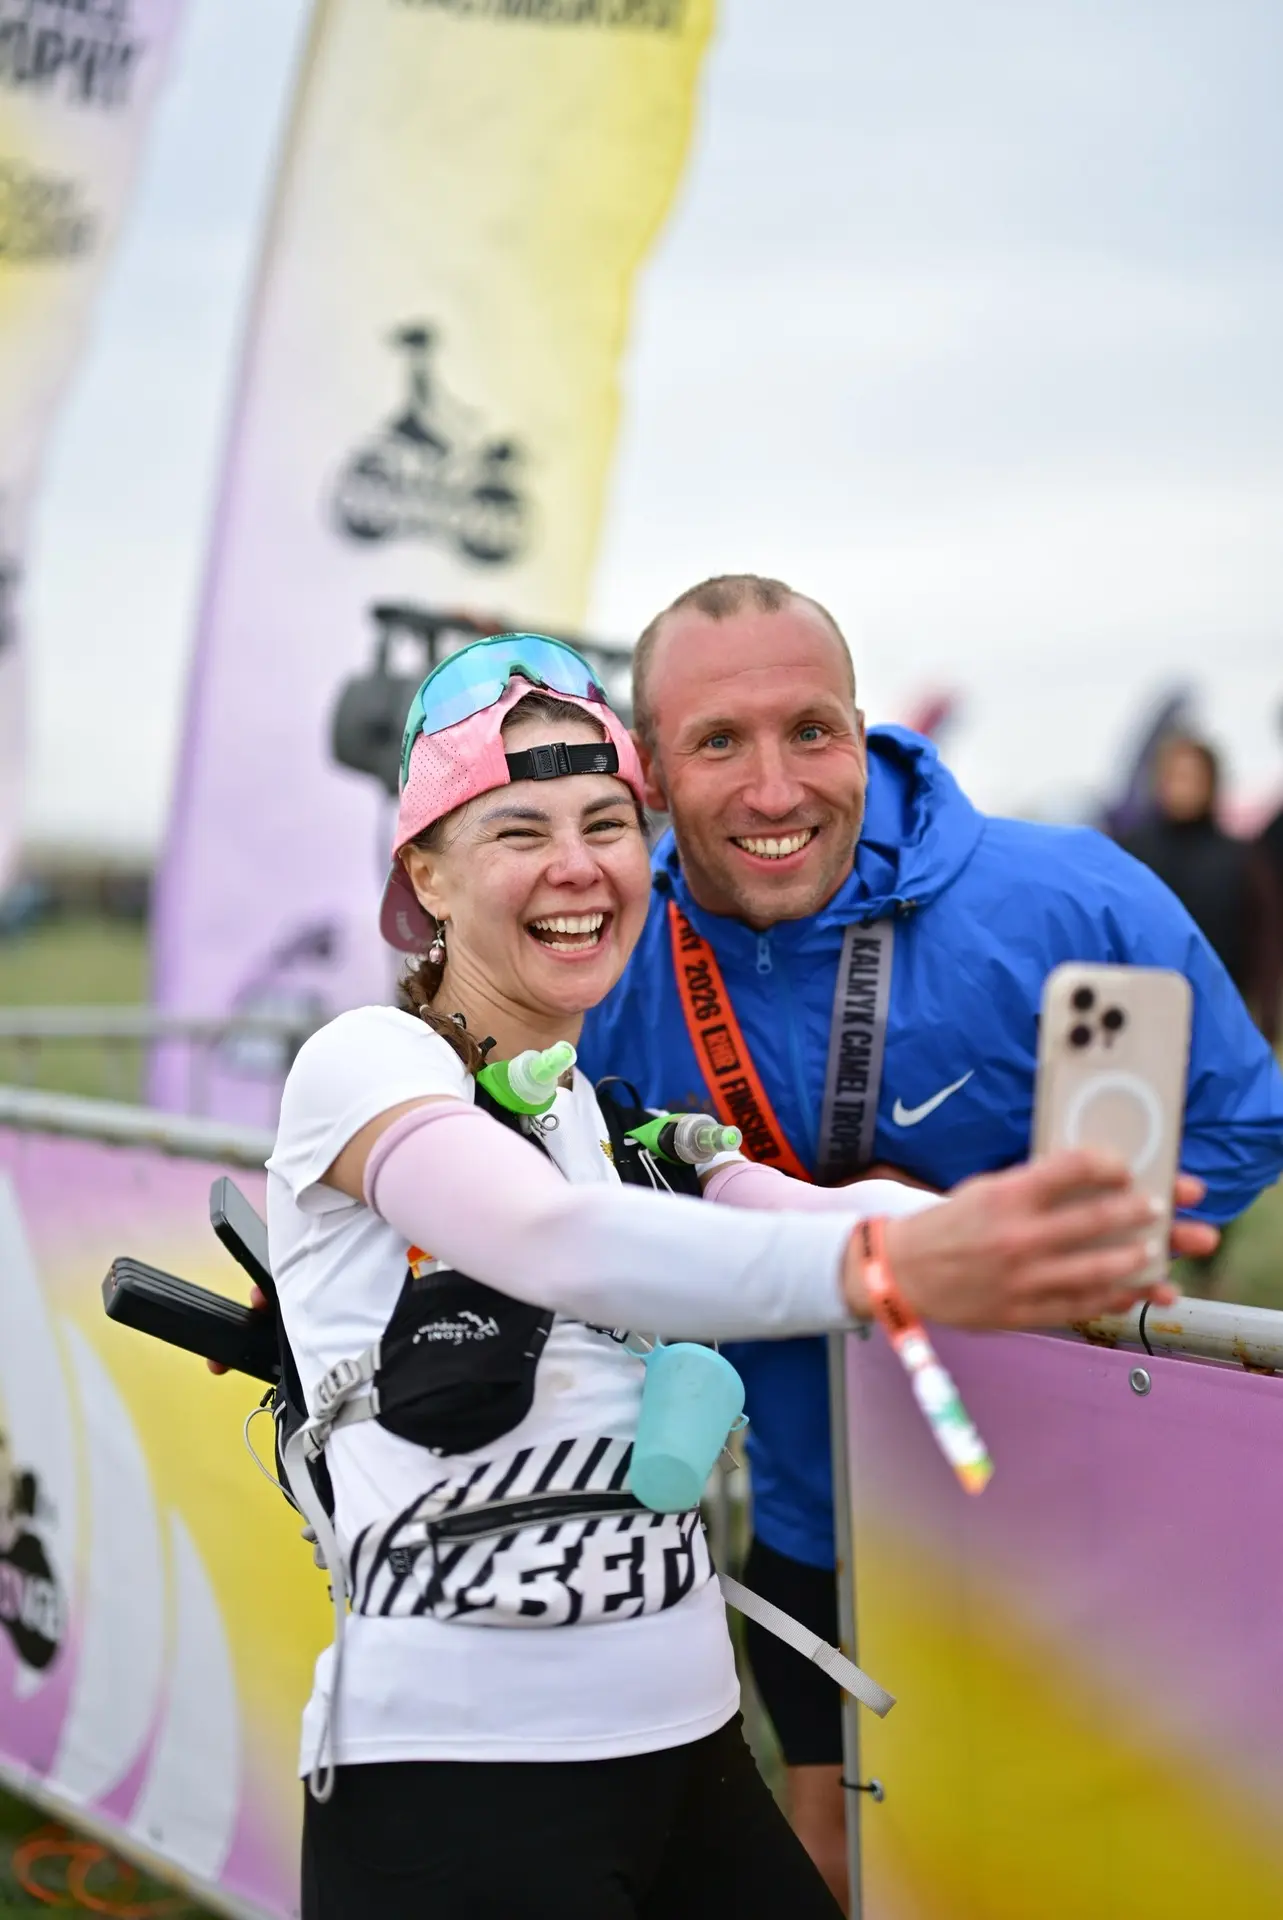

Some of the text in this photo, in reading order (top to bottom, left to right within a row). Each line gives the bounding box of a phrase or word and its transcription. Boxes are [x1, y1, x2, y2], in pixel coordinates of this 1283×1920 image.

[841, 936, 882, 1025] KALMYK
[684, 959, 722, 1021] 2026
[719, 1076, 782, 1161] FINISHER
[836, 1030, 873, 1097] CAMEL
